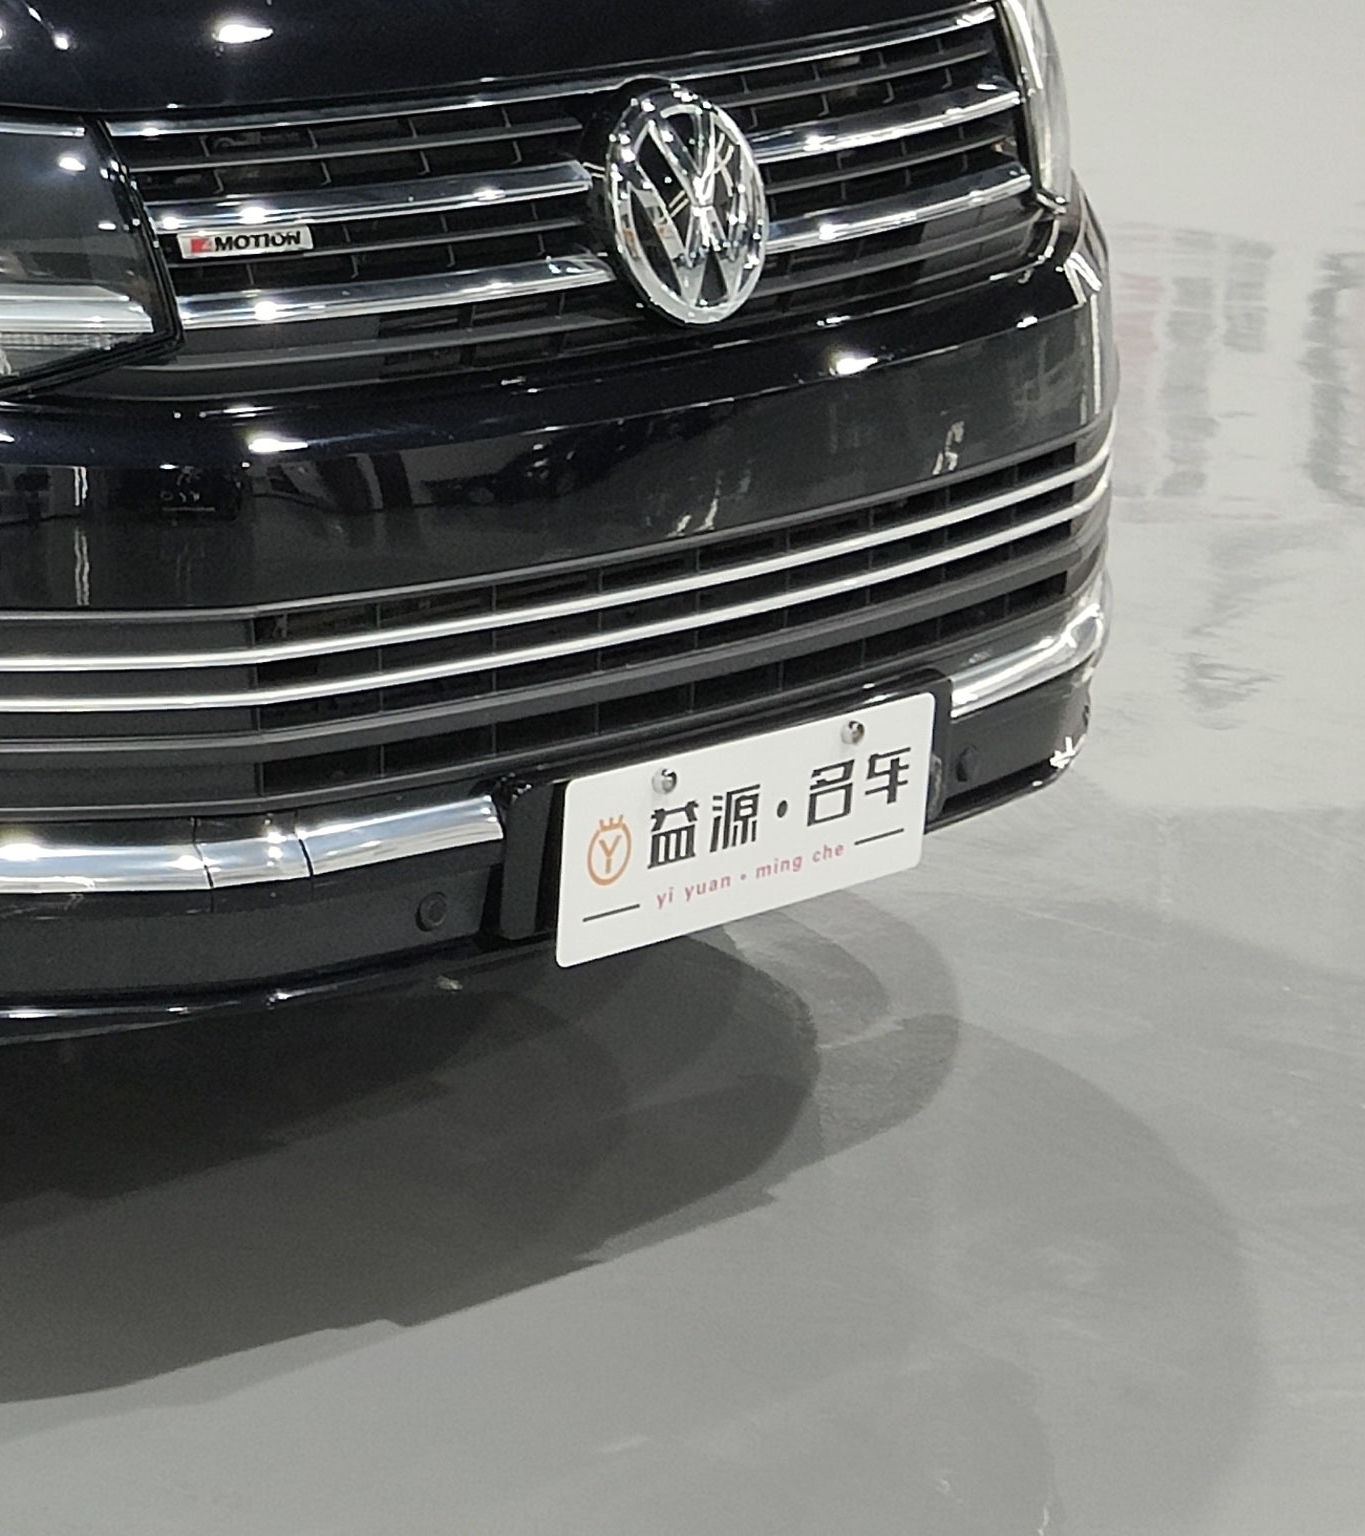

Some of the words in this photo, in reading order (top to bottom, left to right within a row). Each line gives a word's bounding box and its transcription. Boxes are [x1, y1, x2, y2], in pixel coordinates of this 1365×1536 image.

[656, 886, 674, 909] yi
[684, 875, 732, 902] yuan
[755, 855, 803, 879] ming
[811, 843, 845, 863] che
